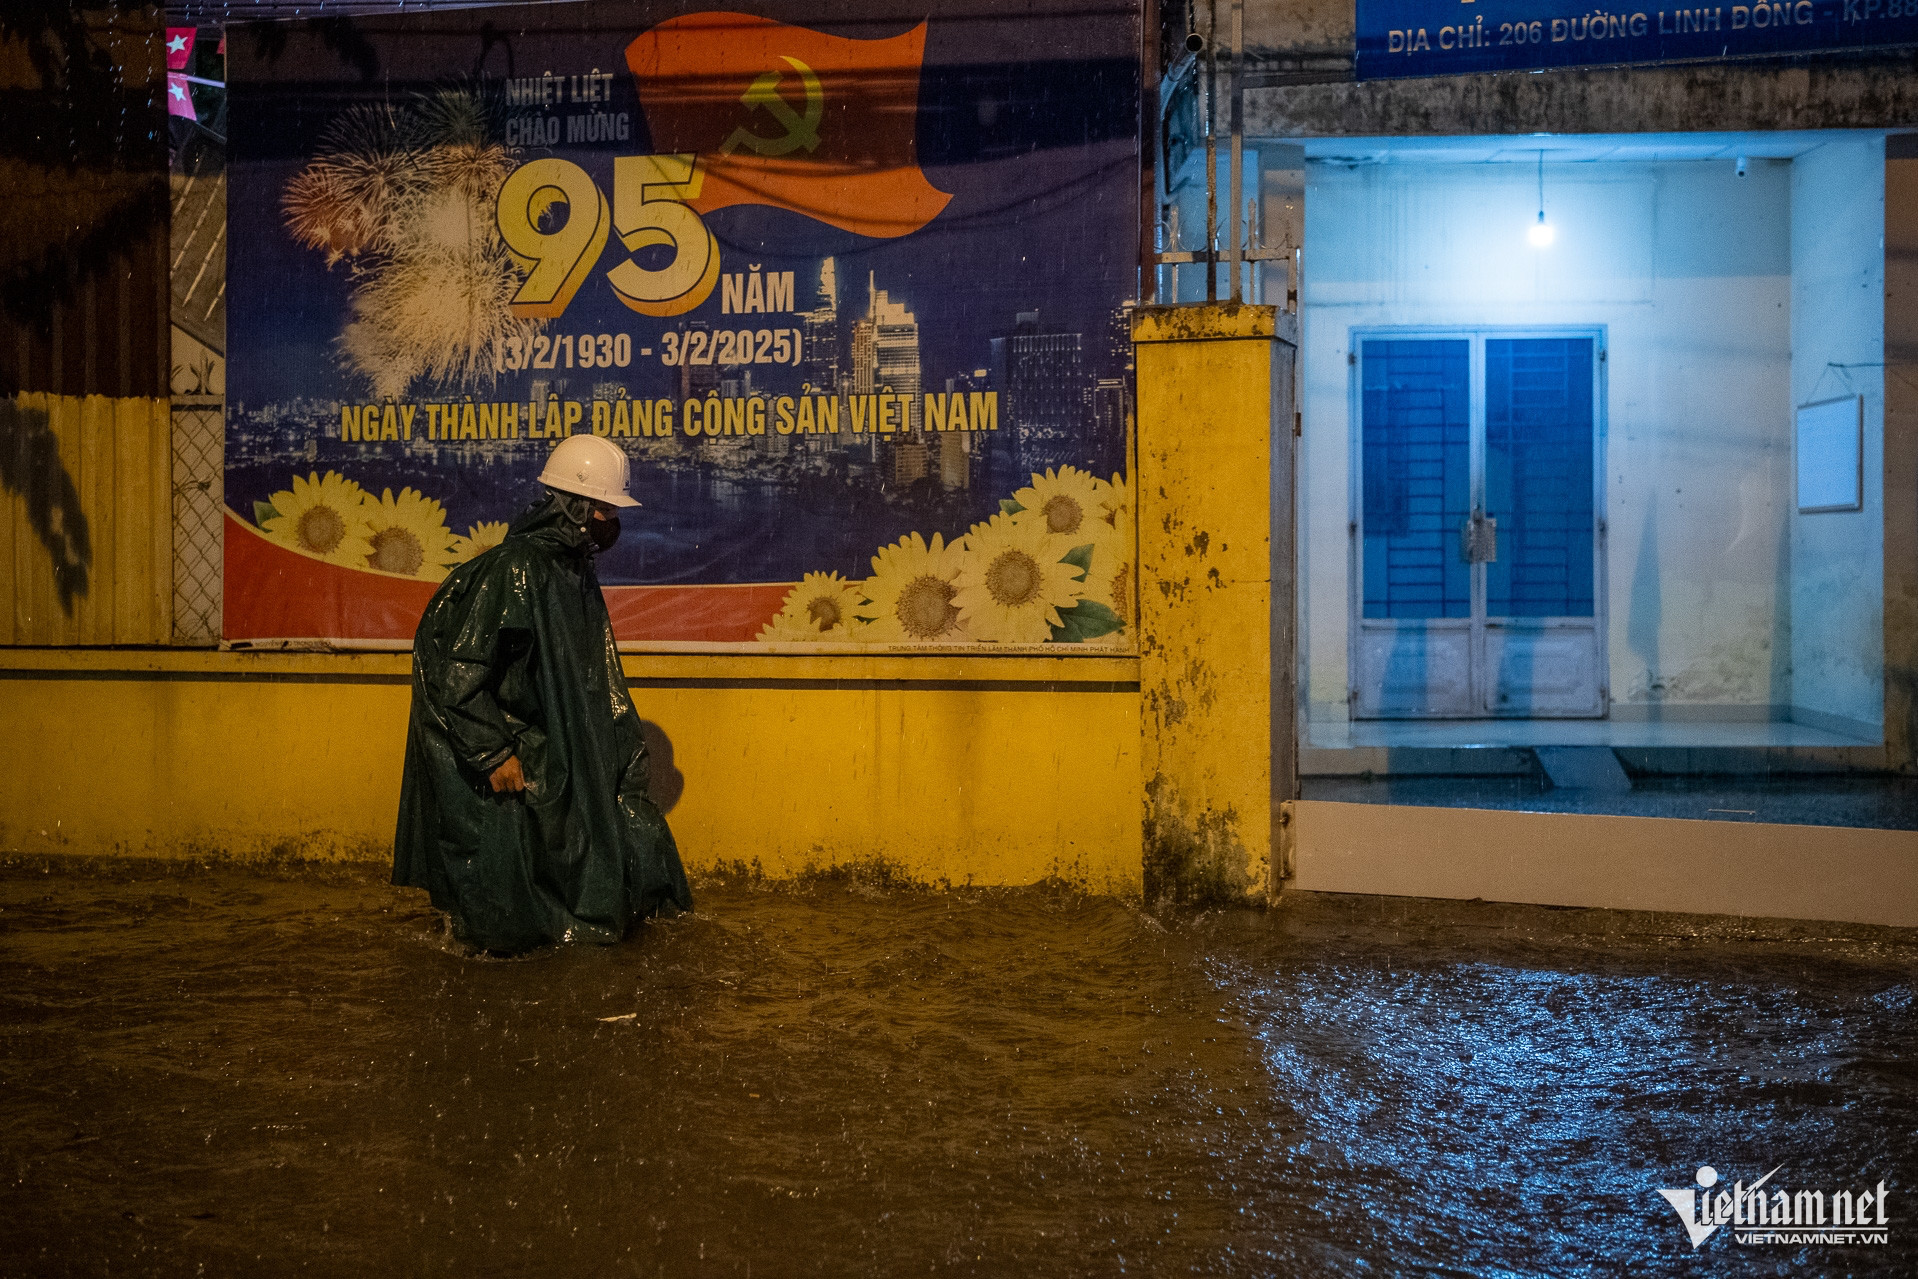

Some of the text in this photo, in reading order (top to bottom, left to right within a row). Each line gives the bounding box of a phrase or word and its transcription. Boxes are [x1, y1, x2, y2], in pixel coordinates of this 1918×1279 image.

[1388, 28, 1431, 57] ĐỊA
[1438, 14, 1490, 50] CHỈ:
[1499, 20, 1542, 46] 206
[1551, 9, 1648, 42] ĐƯỜNG
[1658, 7, 1721, 35] LINH
[505, 67, 614, 111] NHIỆT LIỆT
[505, 108, 630, 147] CHÀO MỪNG
[497, 153, 795, 318] 95 NĂM
[496, 333, 632, 370] (3/2/1930
[661, 328, 802, 367] 3/2/2025)
[340, 383, 999, 447] NGÀY THÀNH LẬP ĐẢNG CỘNG SẢN VIỆT NAM
